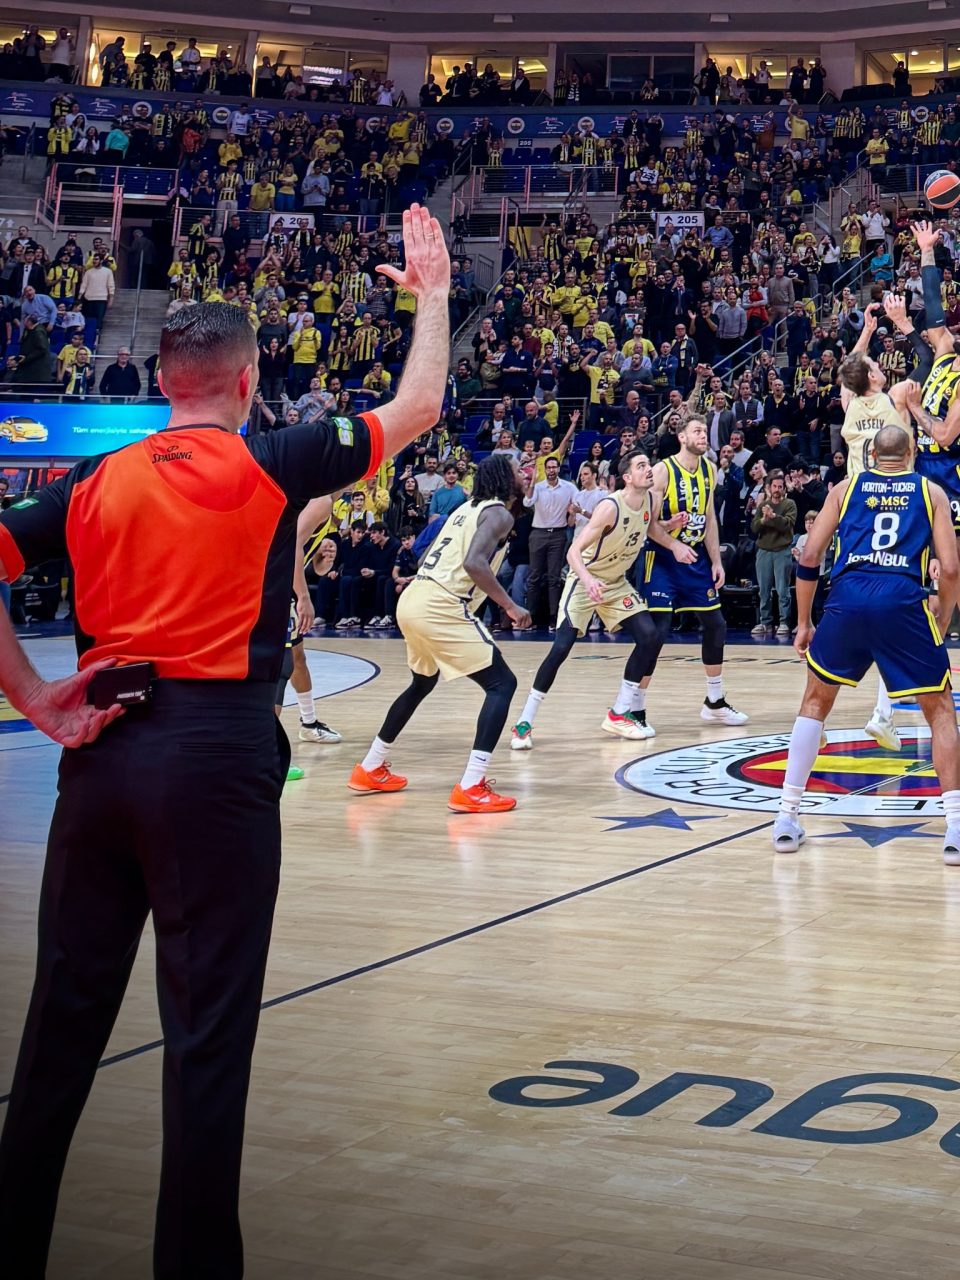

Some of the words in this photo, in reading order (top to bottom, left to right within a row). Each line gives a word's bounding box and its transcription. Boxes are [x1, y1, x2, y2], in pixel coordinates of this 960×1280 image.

[678, 216, 698, 224] 205
[854, 418, 884, 431] VESELY
[152, 451, 192, 464] SPALDING
[861, 482, 916, 492] HORTON-TUCKER
[692, 495, 700, 509] 4
[880, 496, 909, 506] MSC
[871, 512, 900, 550] 8
[625, 532, 640, 546] 13
[424, 537, 452, 570] 3
